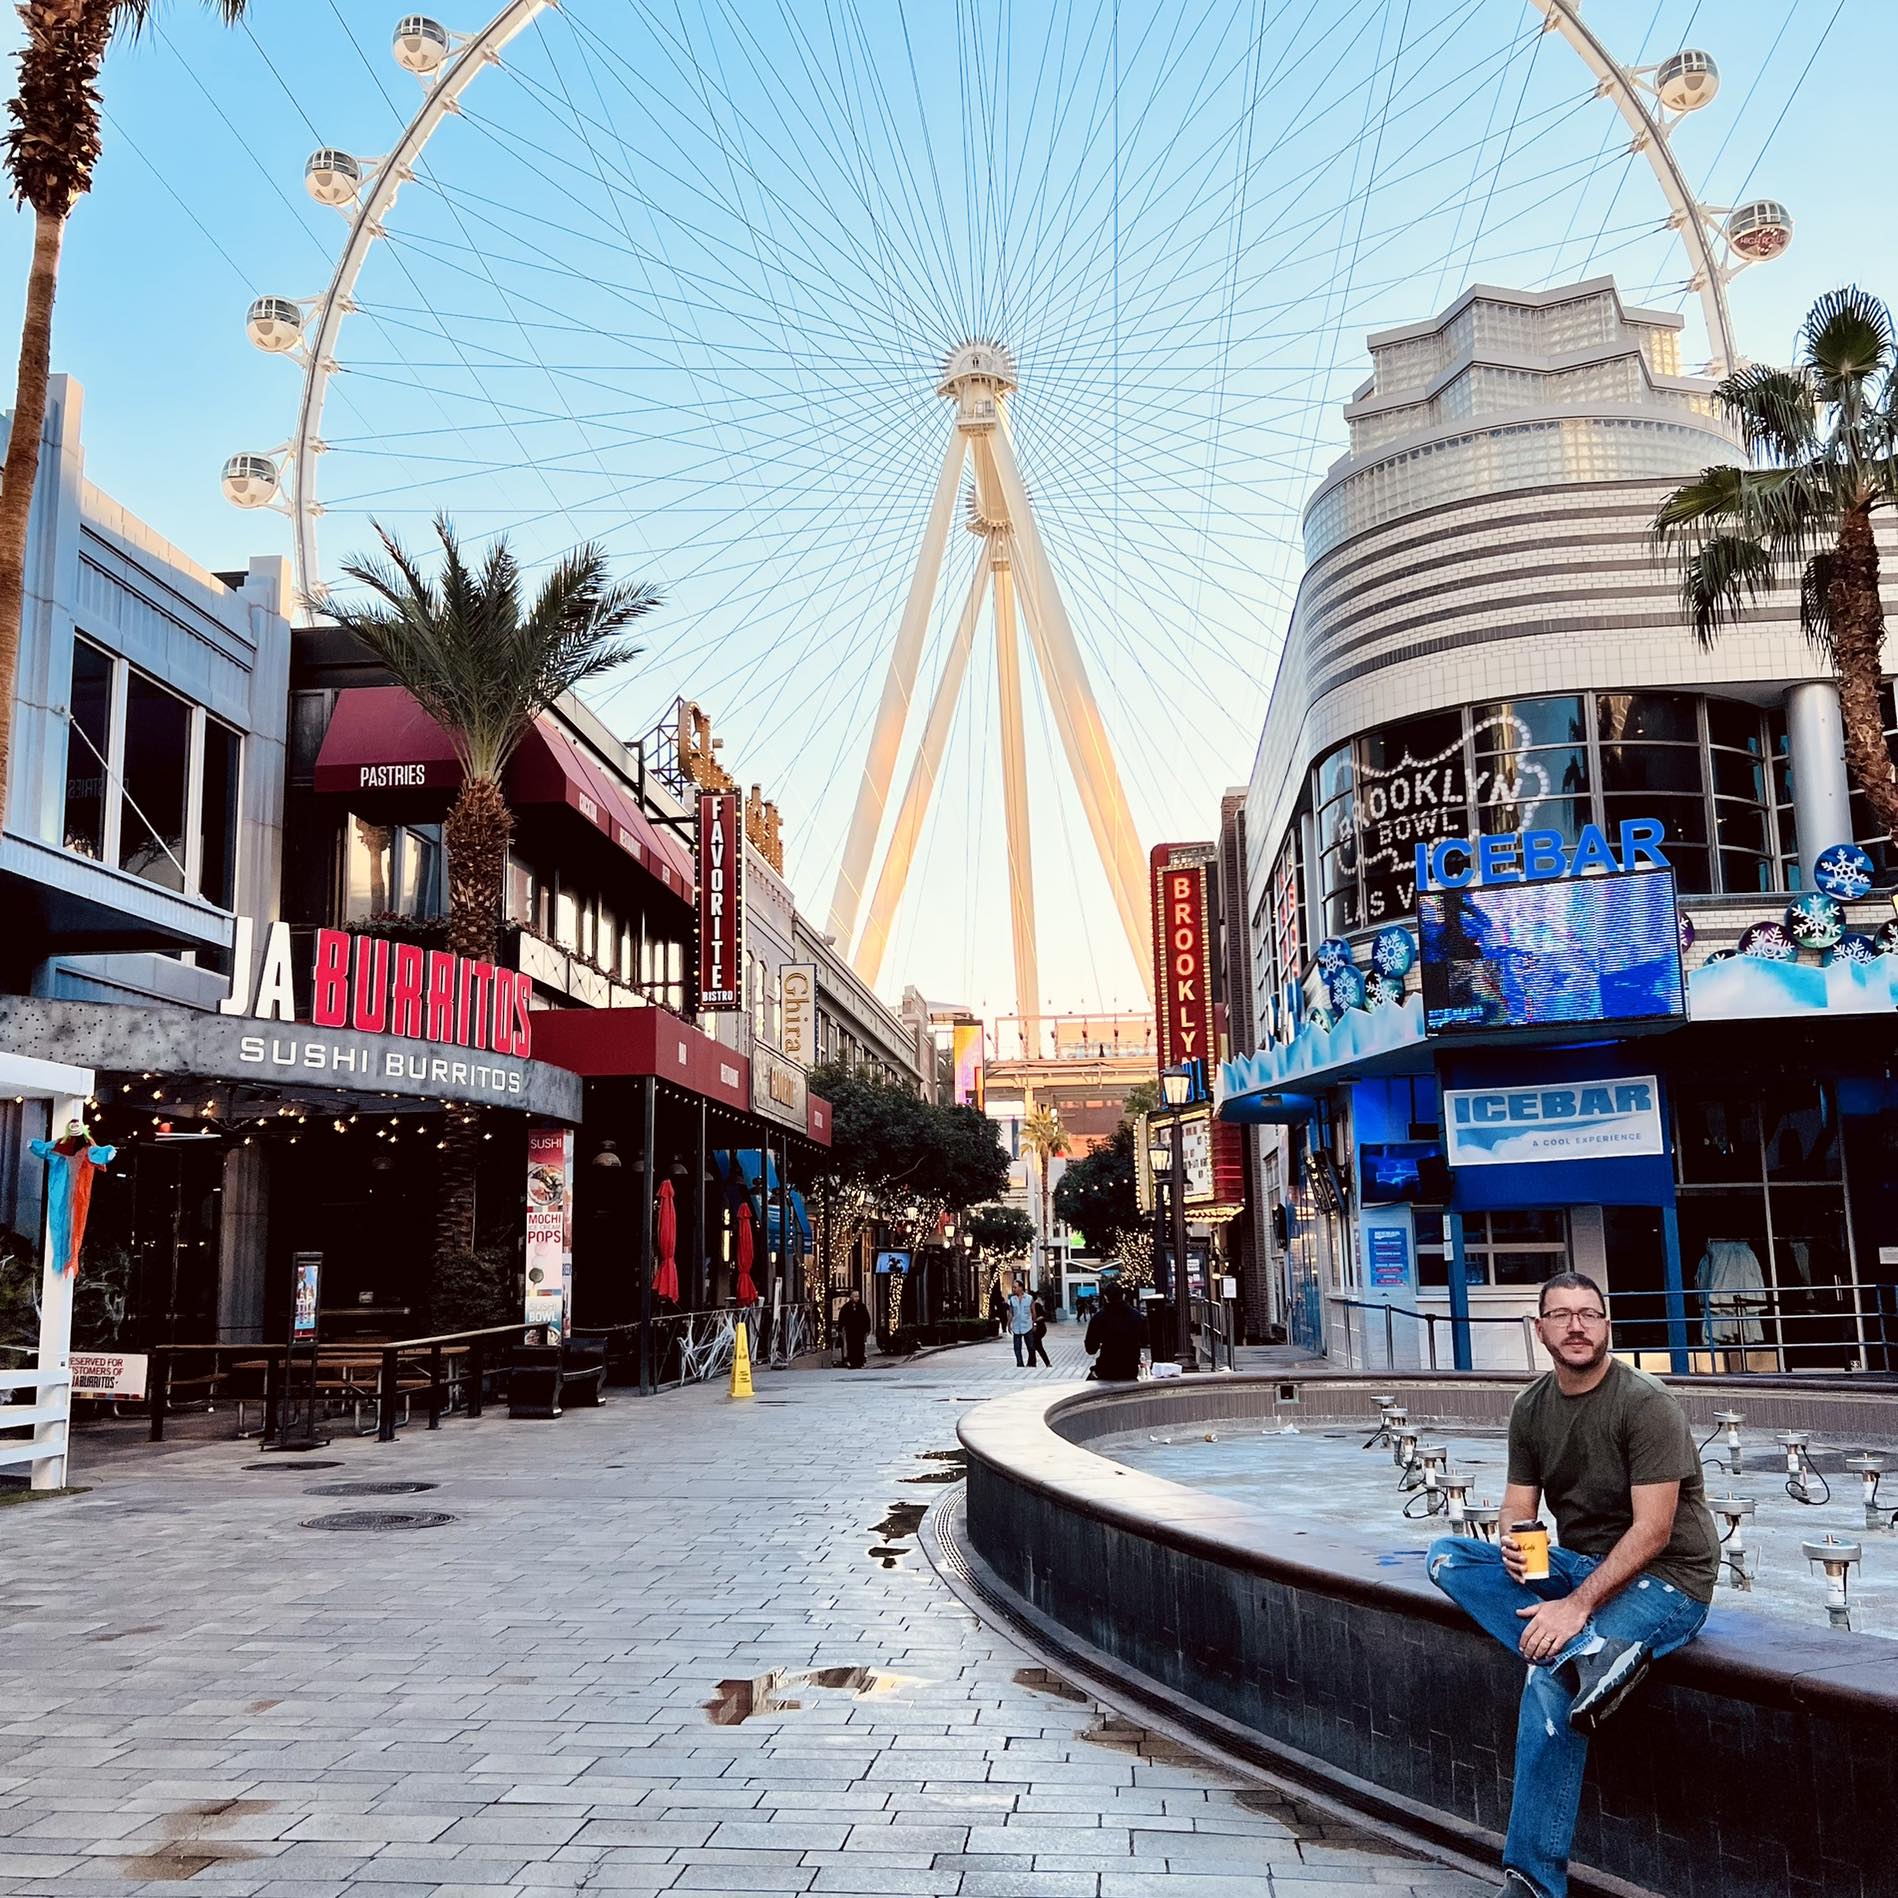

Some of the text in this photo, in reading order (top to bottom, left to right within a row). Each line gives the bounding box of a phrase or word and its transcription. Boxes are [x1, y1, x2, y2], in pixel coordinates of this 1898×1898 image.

[360, 764, 425, 787] PASTRIES
[1378, 806, 1459, 846] BOWL
[1415, 817, 1671, 892] ICEBAR
[710, 797, 724, 989] FAVORITE
[1344, 890, 1385, 926] LAS
[702, 990, 734, 1002] BISTRO
[783, 972, 810, 1063] Ghira
[239, 1036, 521, 1094] SUSHI BURRITOS
[1454, 1083, 1652, 1124] ICEBAR
[530, 1137, 562, 1150] SUSHI
[1532, 1132, 1642, 1148] A COOL EXPERIENCE
[528, 1213, 561, 1225] MOCHI
[528, 1230, 561, 1244] POPS
[528, 1311, 557, 1322] BOWL
[69, 1356, 123, 1367] ESERVED FOR
[71, 1366, 124, 1377] STOMERS OF
